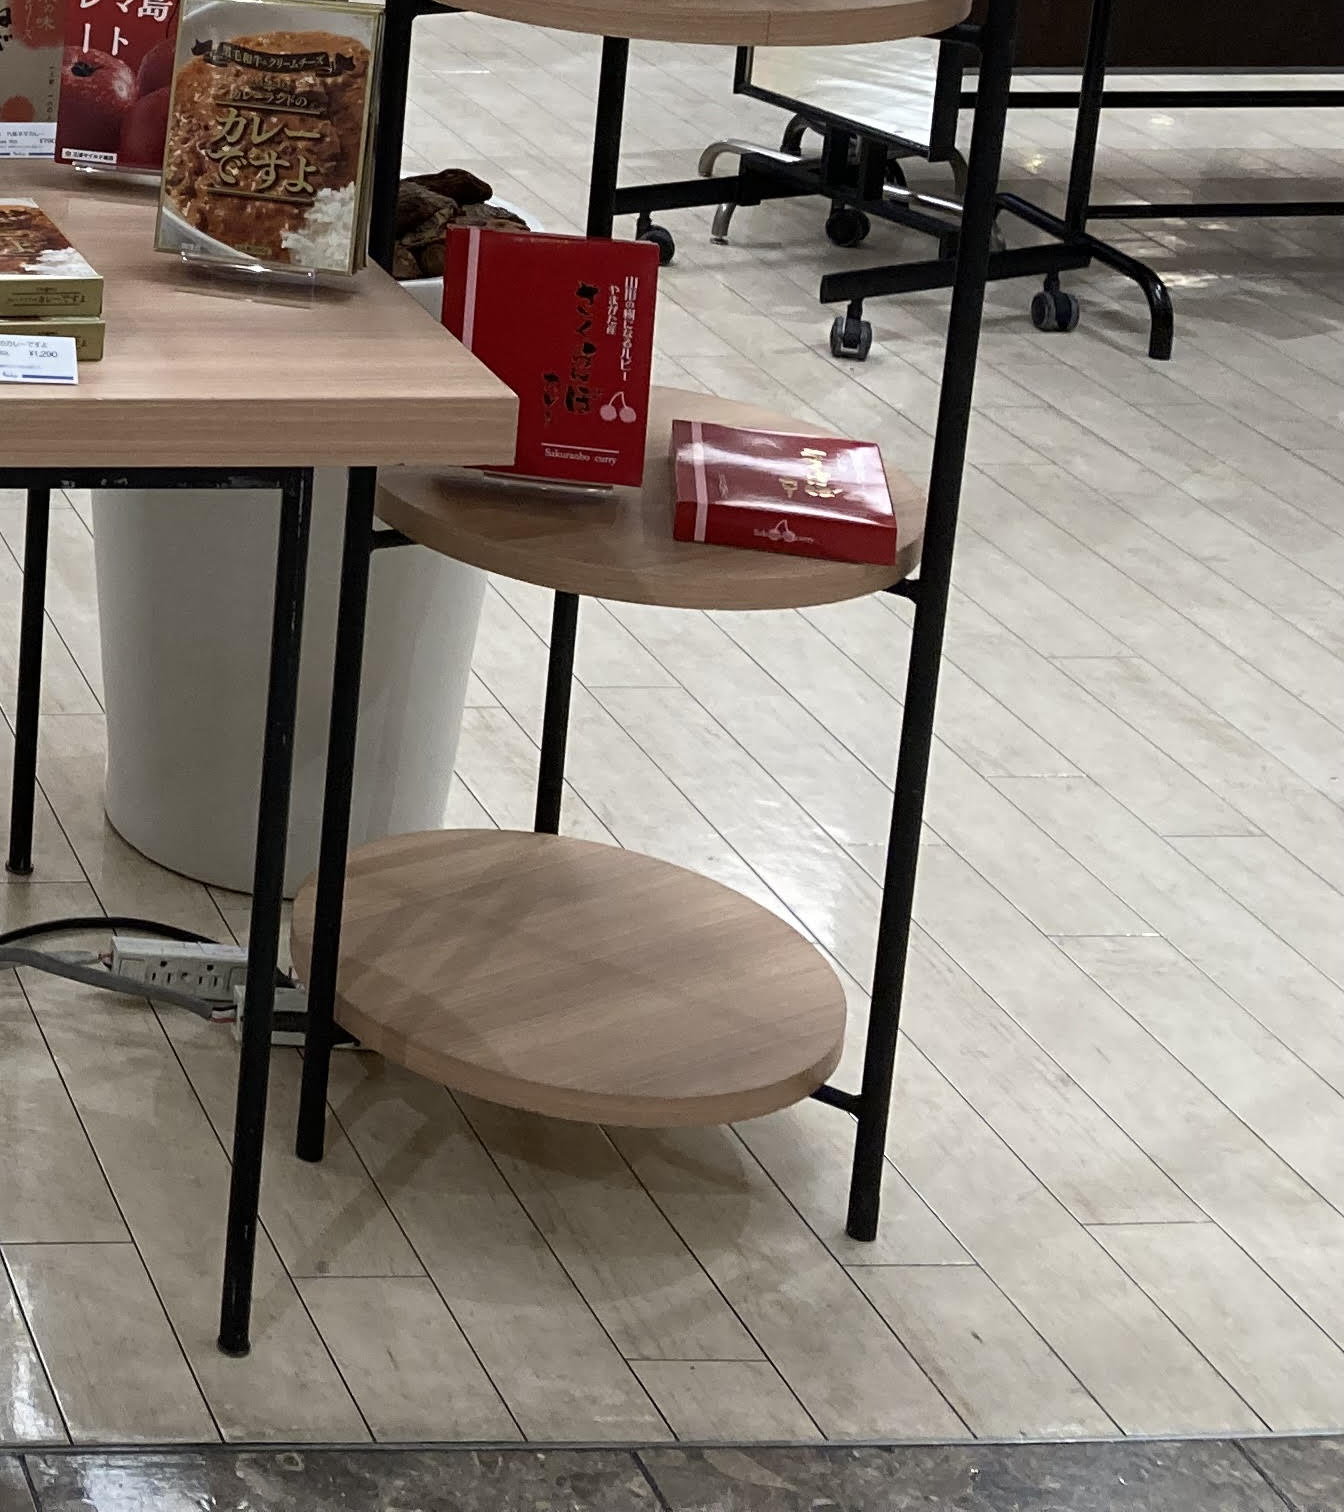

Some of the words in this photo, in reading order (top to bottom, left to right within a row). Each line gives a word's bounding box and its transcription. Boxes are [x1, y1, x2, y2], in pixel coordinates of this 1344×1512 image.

[210, 108, 321, 144] カレー
[207, 151, 317, 193] ですよ
[544, 448, 591, 462] Sakuranbo
[595, 452, 617, 465] curry
